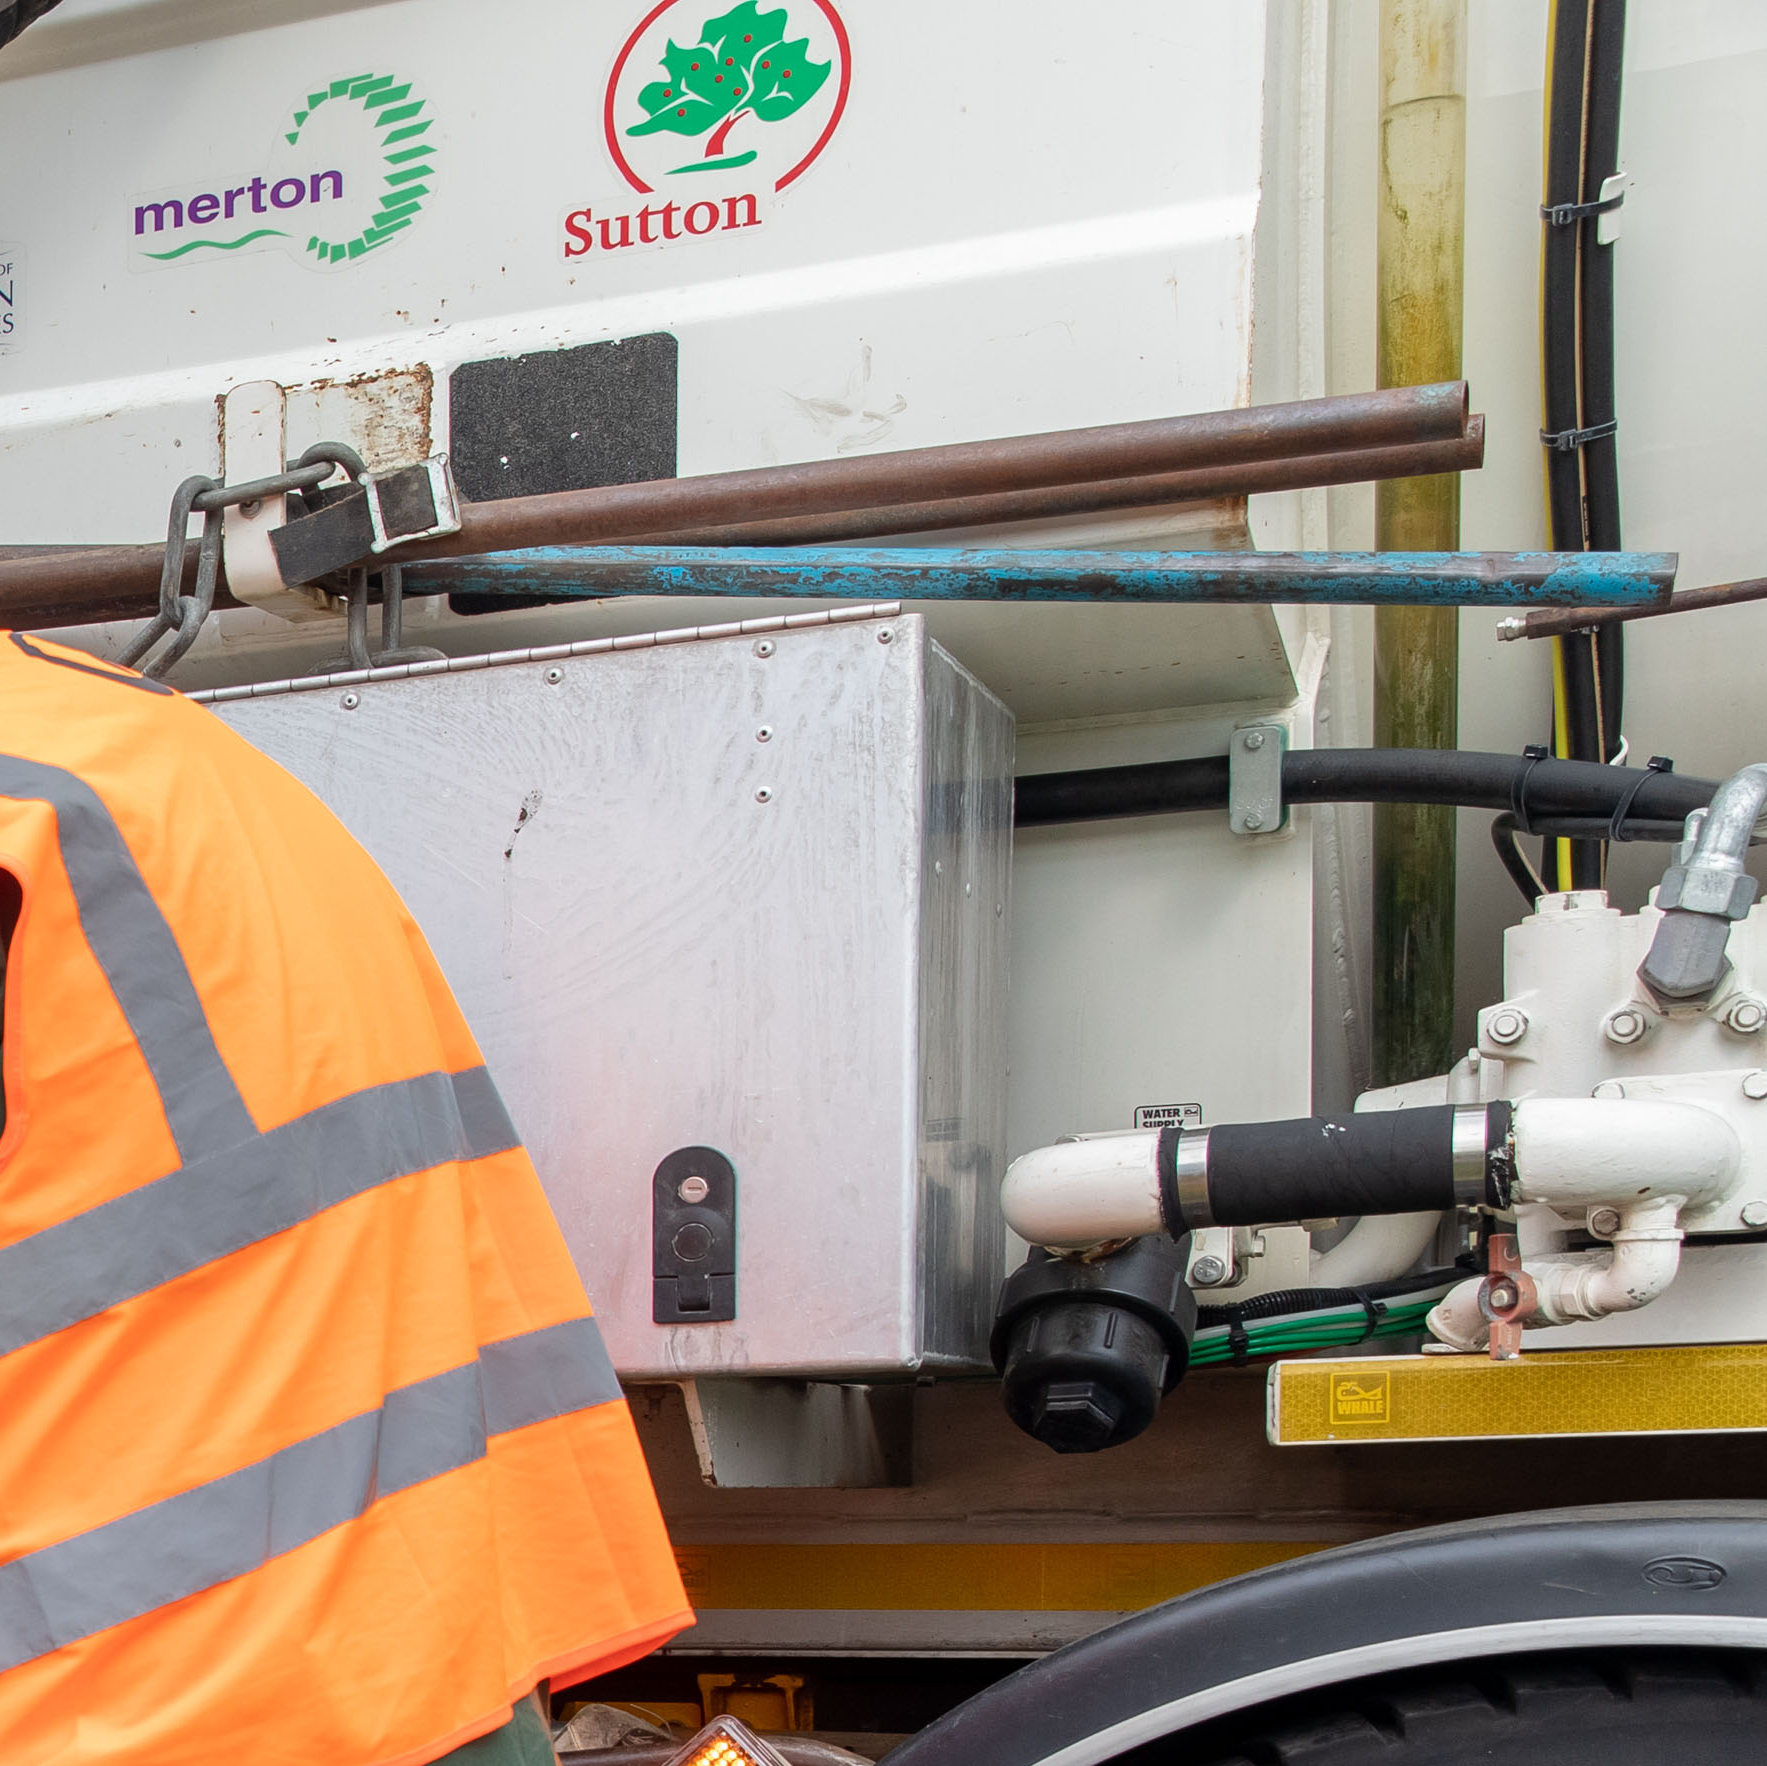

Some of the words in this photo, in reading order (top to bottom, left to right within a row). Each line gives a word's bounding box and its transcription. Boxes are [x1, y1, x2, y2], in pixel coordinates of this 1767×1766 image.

[134, 165, 343, 234] merton
[563, 192, 763, 258] Sutton
[1142, 1108, 1180, 1119] WATER
[1338, 1401, 1384, 1417] WHALE
